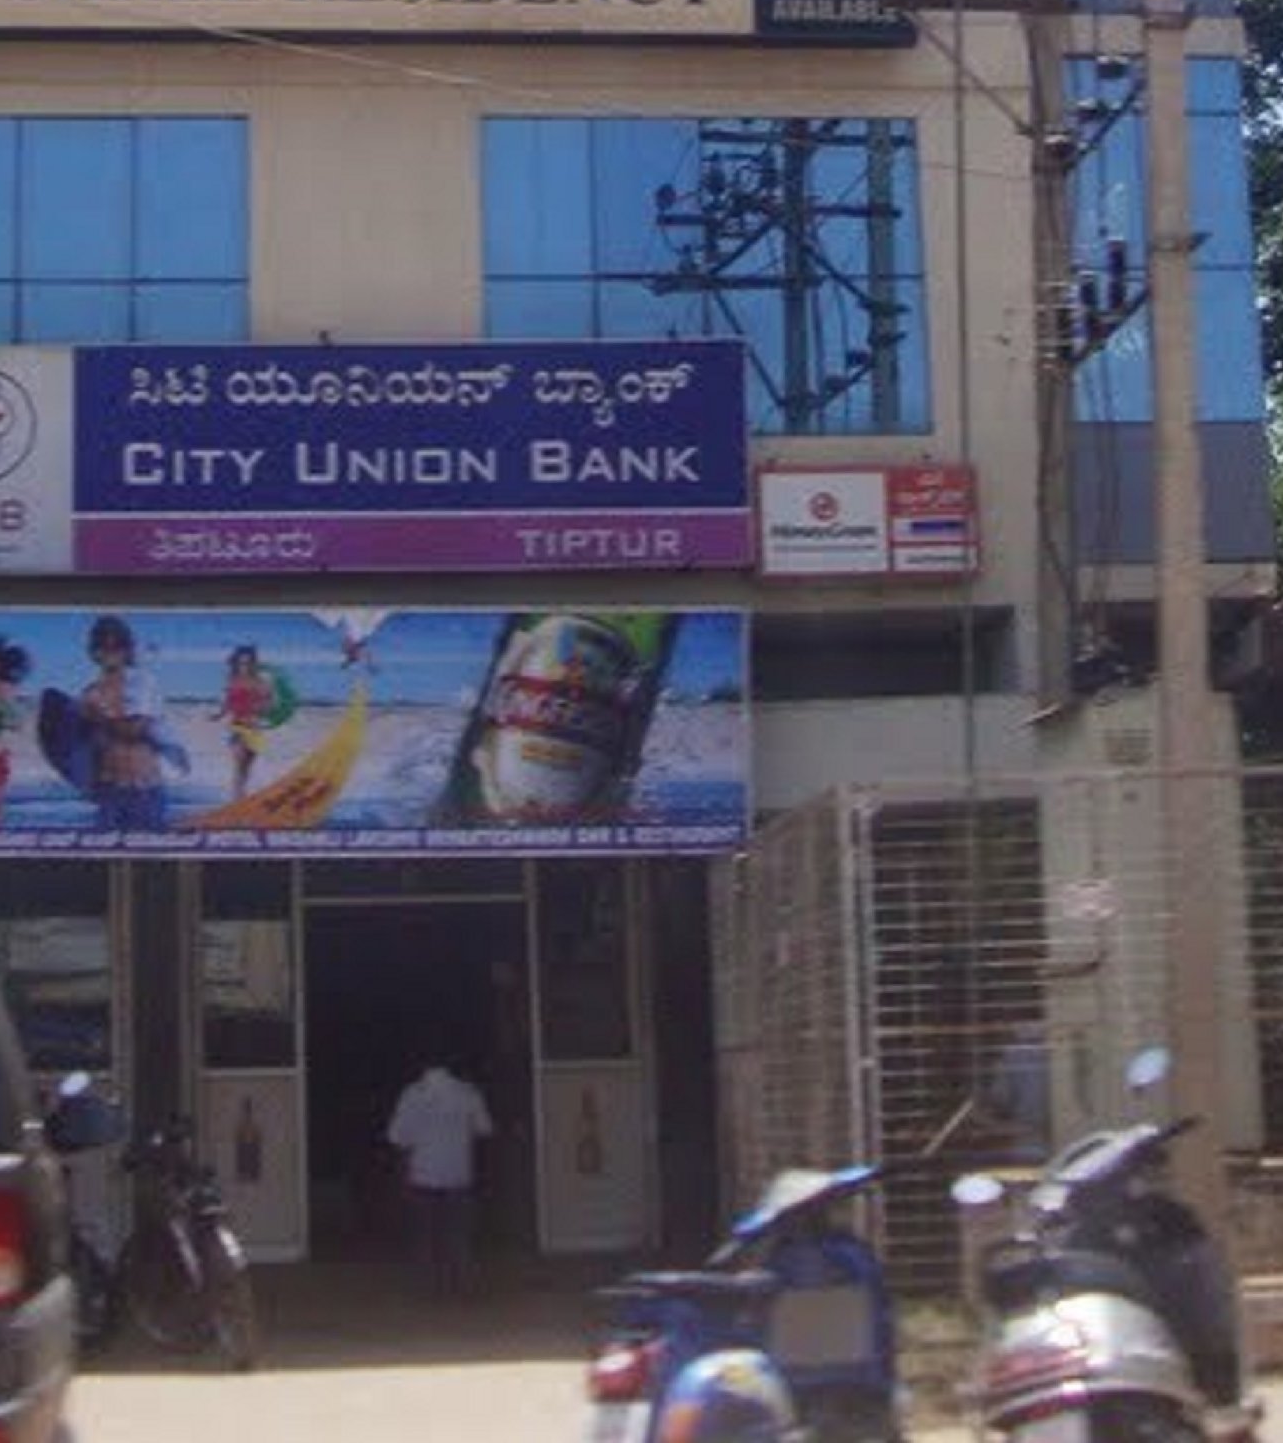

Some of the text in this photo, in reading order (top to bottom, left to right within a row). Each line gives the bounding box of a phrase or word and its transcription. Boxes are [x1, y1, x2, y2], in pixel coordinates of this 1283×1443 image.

[226, 361, 514, 406] ಯೂನಿಯನ್
[533, 363, 694, 427] ಬ್ಯಾಂಕ್
[518, 529, 683, 557] TIPTUR
